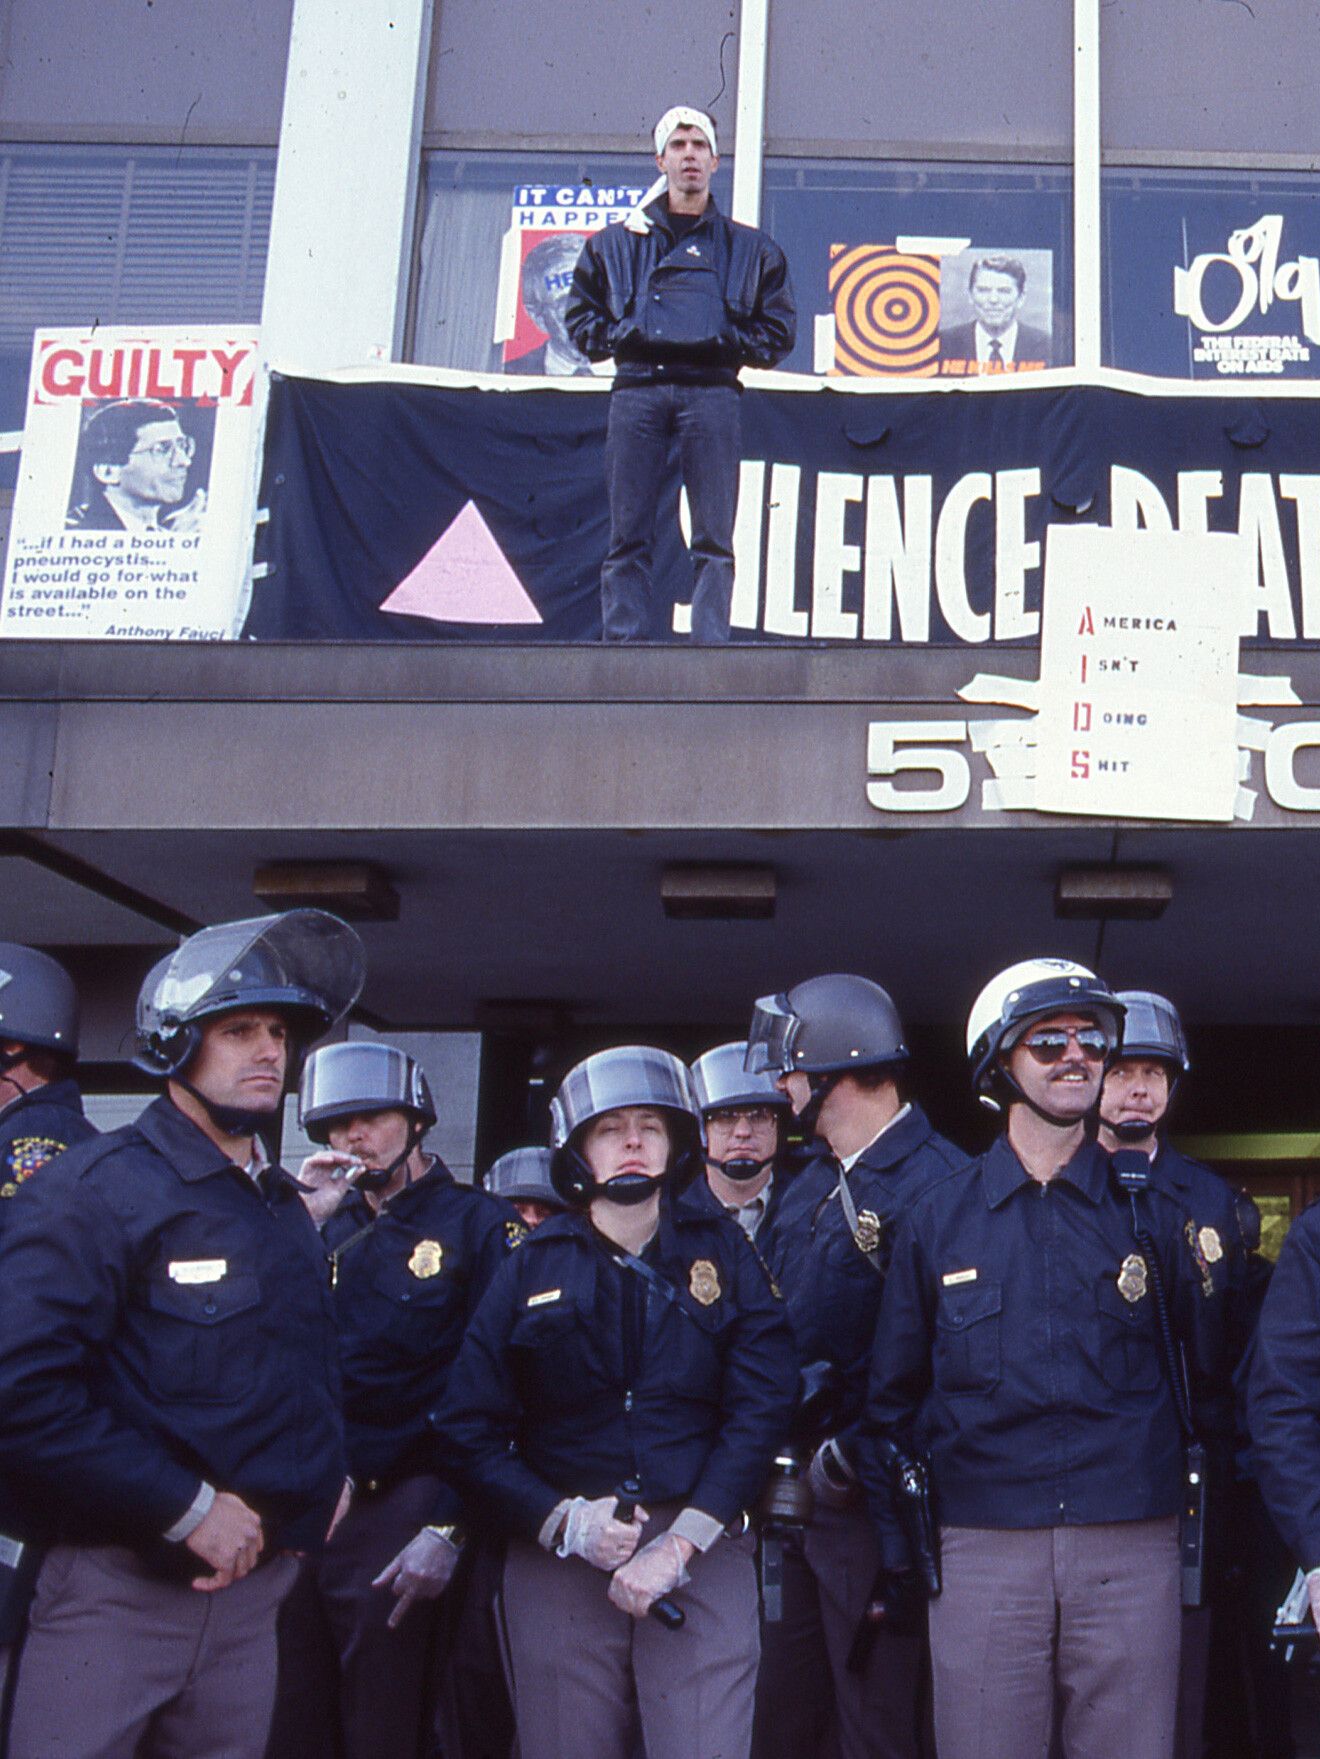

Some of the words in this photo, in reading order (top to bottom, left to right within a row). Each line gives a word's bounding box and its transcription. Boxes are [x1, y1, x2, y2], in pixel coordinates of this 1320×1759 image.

[519, 189, 547, 205] IT
[556, 188, 643, 206] CAN'T
[520, 211, 630, 226] HAPPE
[41, 349, 250, 397] GUILTY
[58, 537, 64, 548] I
[71, 537, 107, 549] had
[113, 539, 124, 549] a
[131, 537, 175, 549] bout
[181, 536, 200, 549] of
[14, 553, 166, 569] pneumocystis...
[12, 572, 18, 584] I
[24, 570, 80, 583] would
[87, 573, 110, 585] go
[117, 569, 148, 582] for
[150, 570, 199, 583] what
[10, 588, 24, 599] is
[31, 587, 118, 600] available
[125, 589, 148, 600] on
[155, 587, 187, 599] the
[105, 624, 174, 640] Anthony
[179, 626, 226, 641] Fauci
